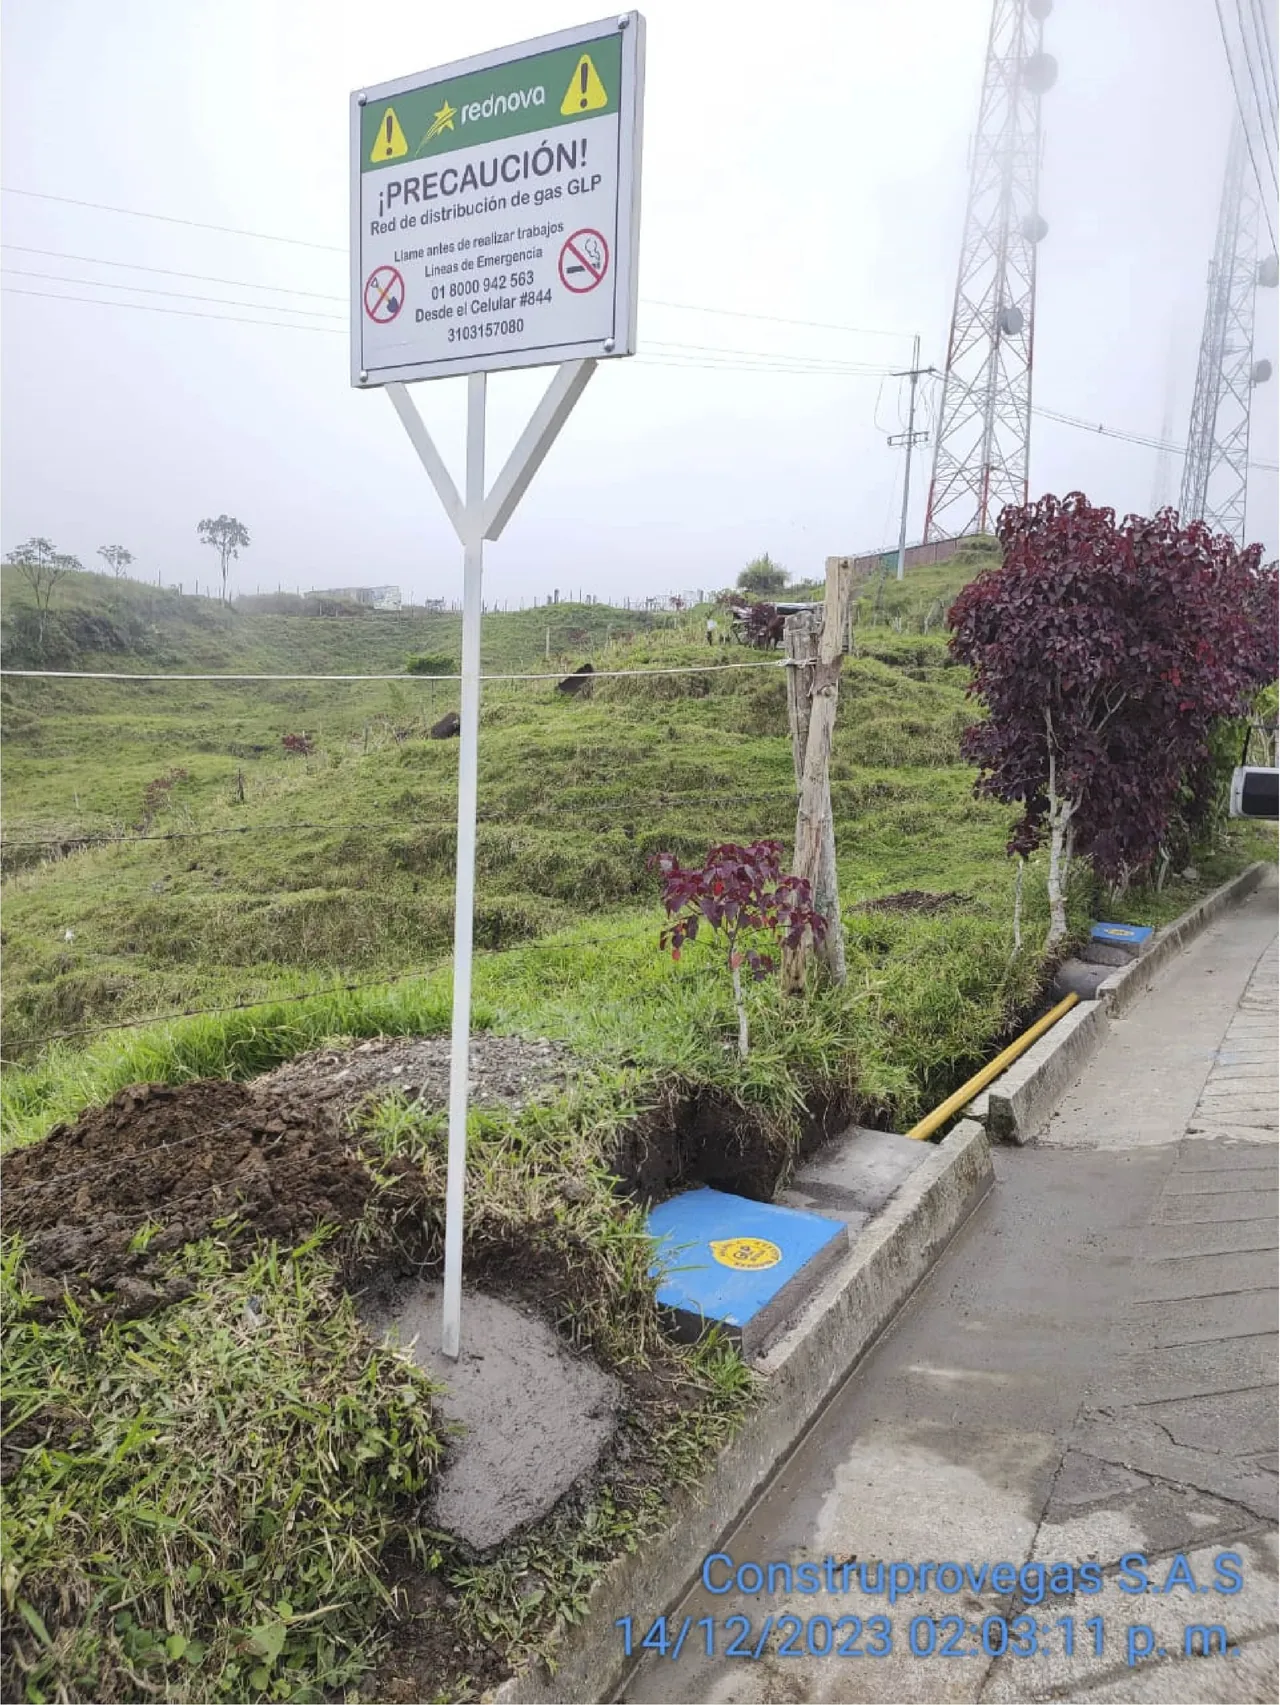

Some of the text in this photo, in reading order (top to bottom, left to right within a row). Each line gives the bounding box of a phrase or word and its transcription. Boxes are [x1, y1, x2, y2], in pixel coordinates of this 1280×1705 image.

[461, 85, 545, 124] rednova
[378, 138, 588, 216] ¡PRECAUCIÓN!
[370, 174, 602, 236] Red de distribución de gas GLP
[394, 221, 564, 262] Llame antes de realizar trabajos
[461, 258, 475, 272] de
[431, 270, 535, 301] 01 8000 942 563
[415, 288, 553, 323] Desde el Celular #844
[447, 318, 524, 342] 3103157080
